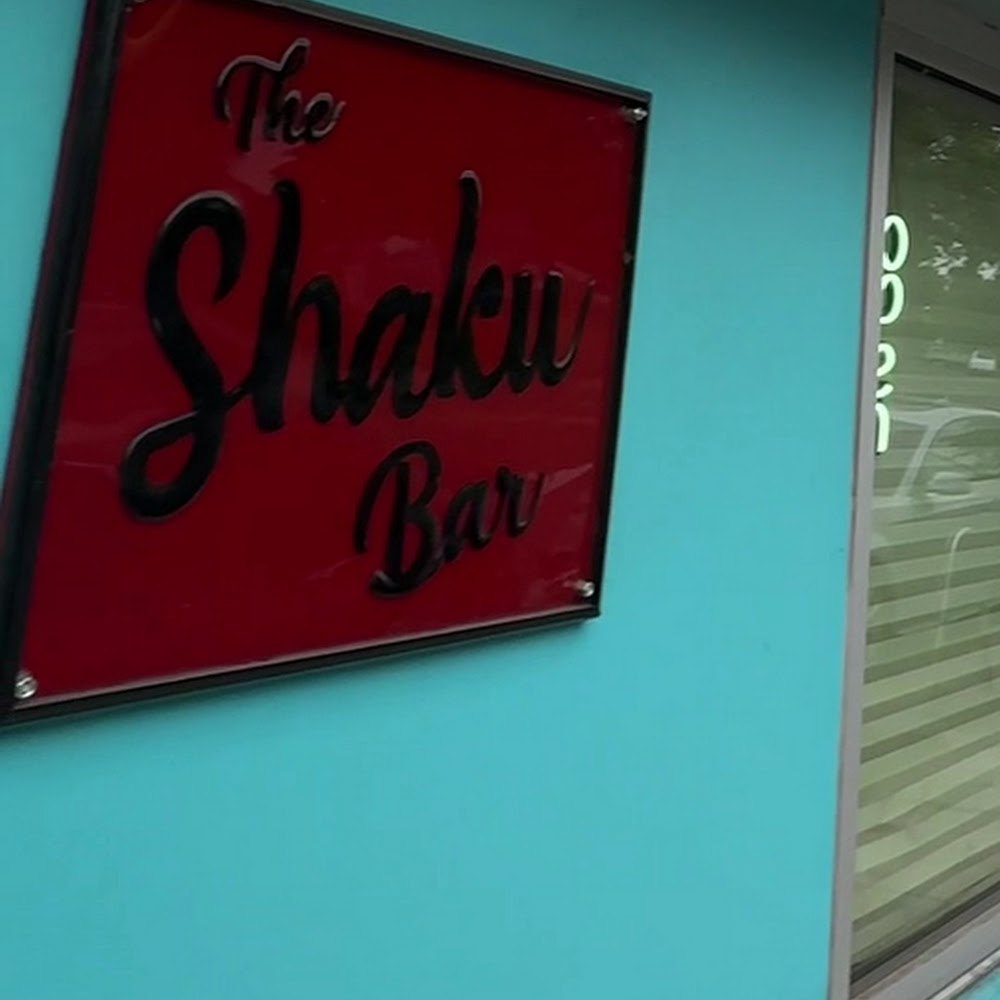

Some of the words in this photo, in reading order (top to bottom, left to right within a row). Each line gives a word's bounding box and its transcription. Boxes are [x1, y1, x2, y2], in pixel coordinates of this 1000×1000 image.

[215, 38, 346, 152] The
[119, 170, 594, 523] Shaku
[353, 439, 545, 597] Bar
